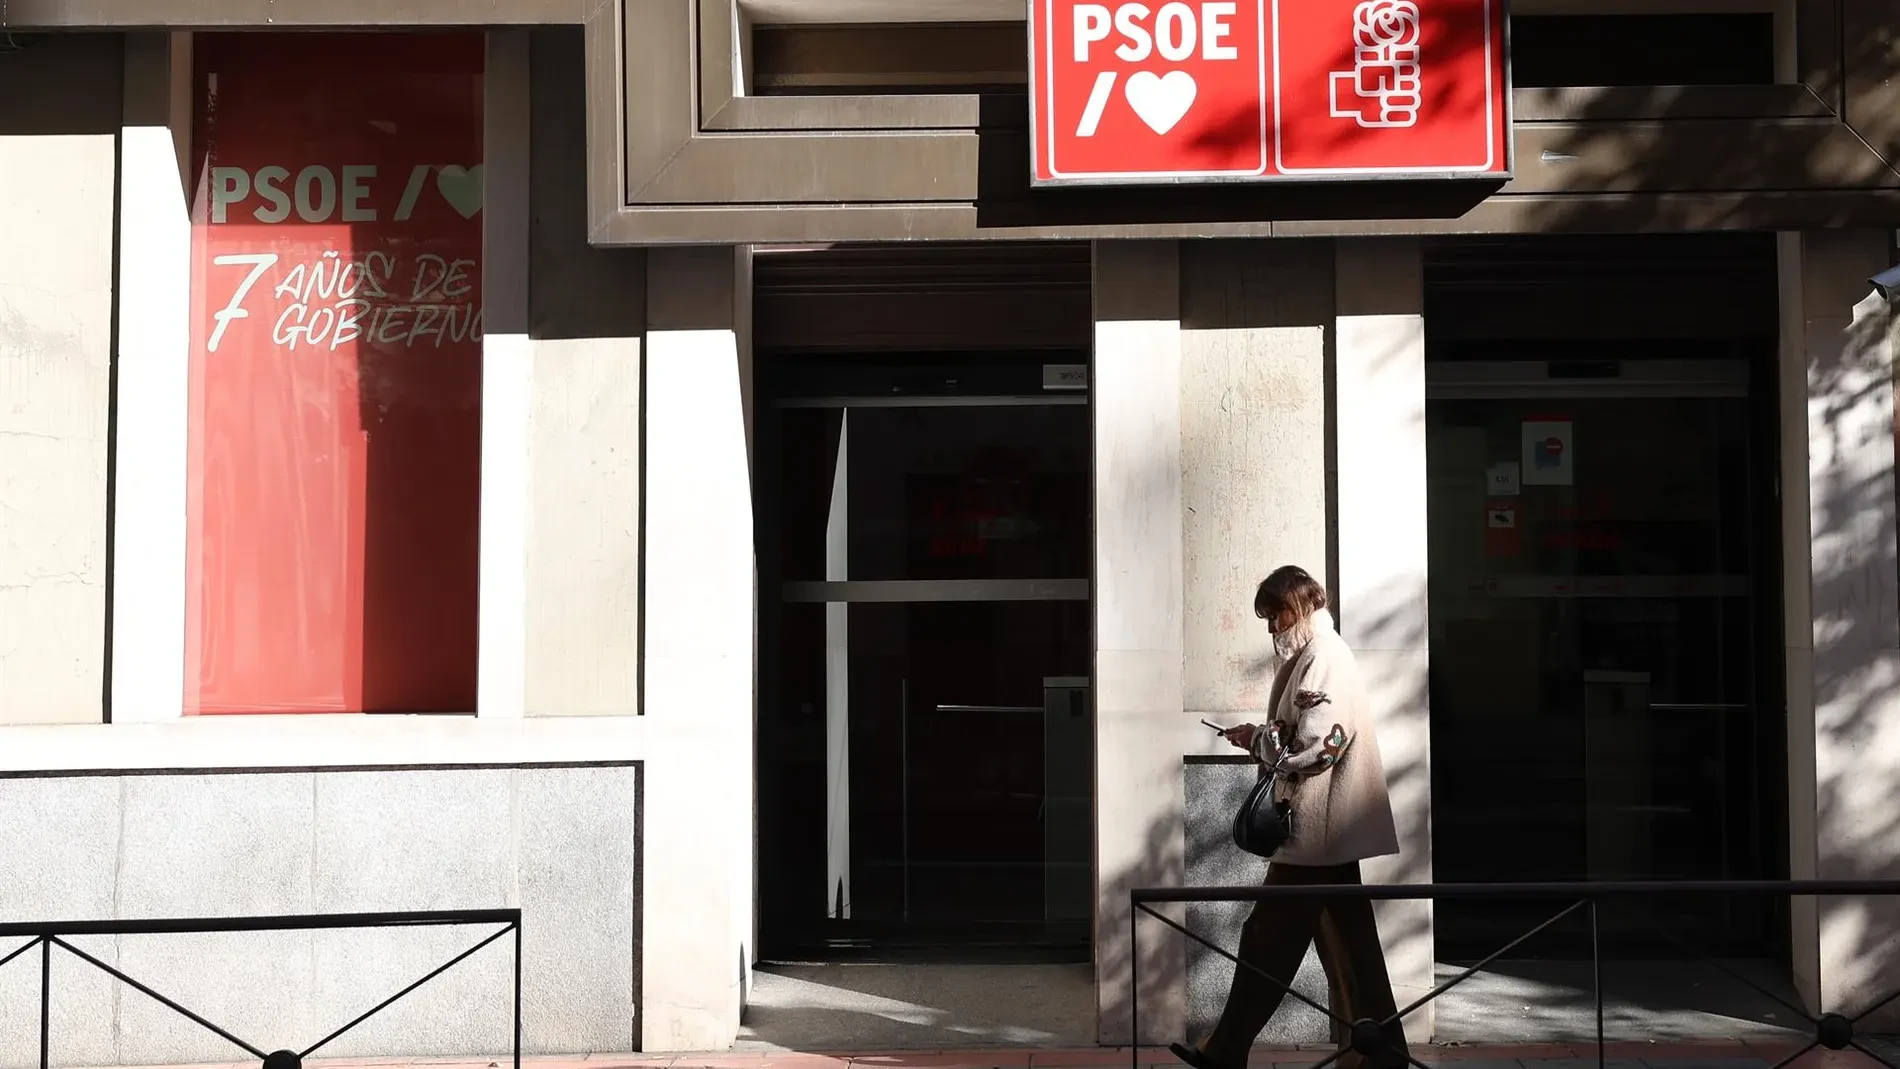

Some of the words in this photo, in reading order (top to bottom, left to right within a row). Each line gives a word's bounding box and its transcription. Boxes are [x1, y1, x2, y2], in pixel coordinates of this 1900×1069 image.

[1073, 1, 1238, 62] PSOE
[211, 165, 377, 223] PSOE
[207, 253, 279, 352] 7
[274, 250, 396, 301] AÑOS
[410, 254, 476, 302] DE
